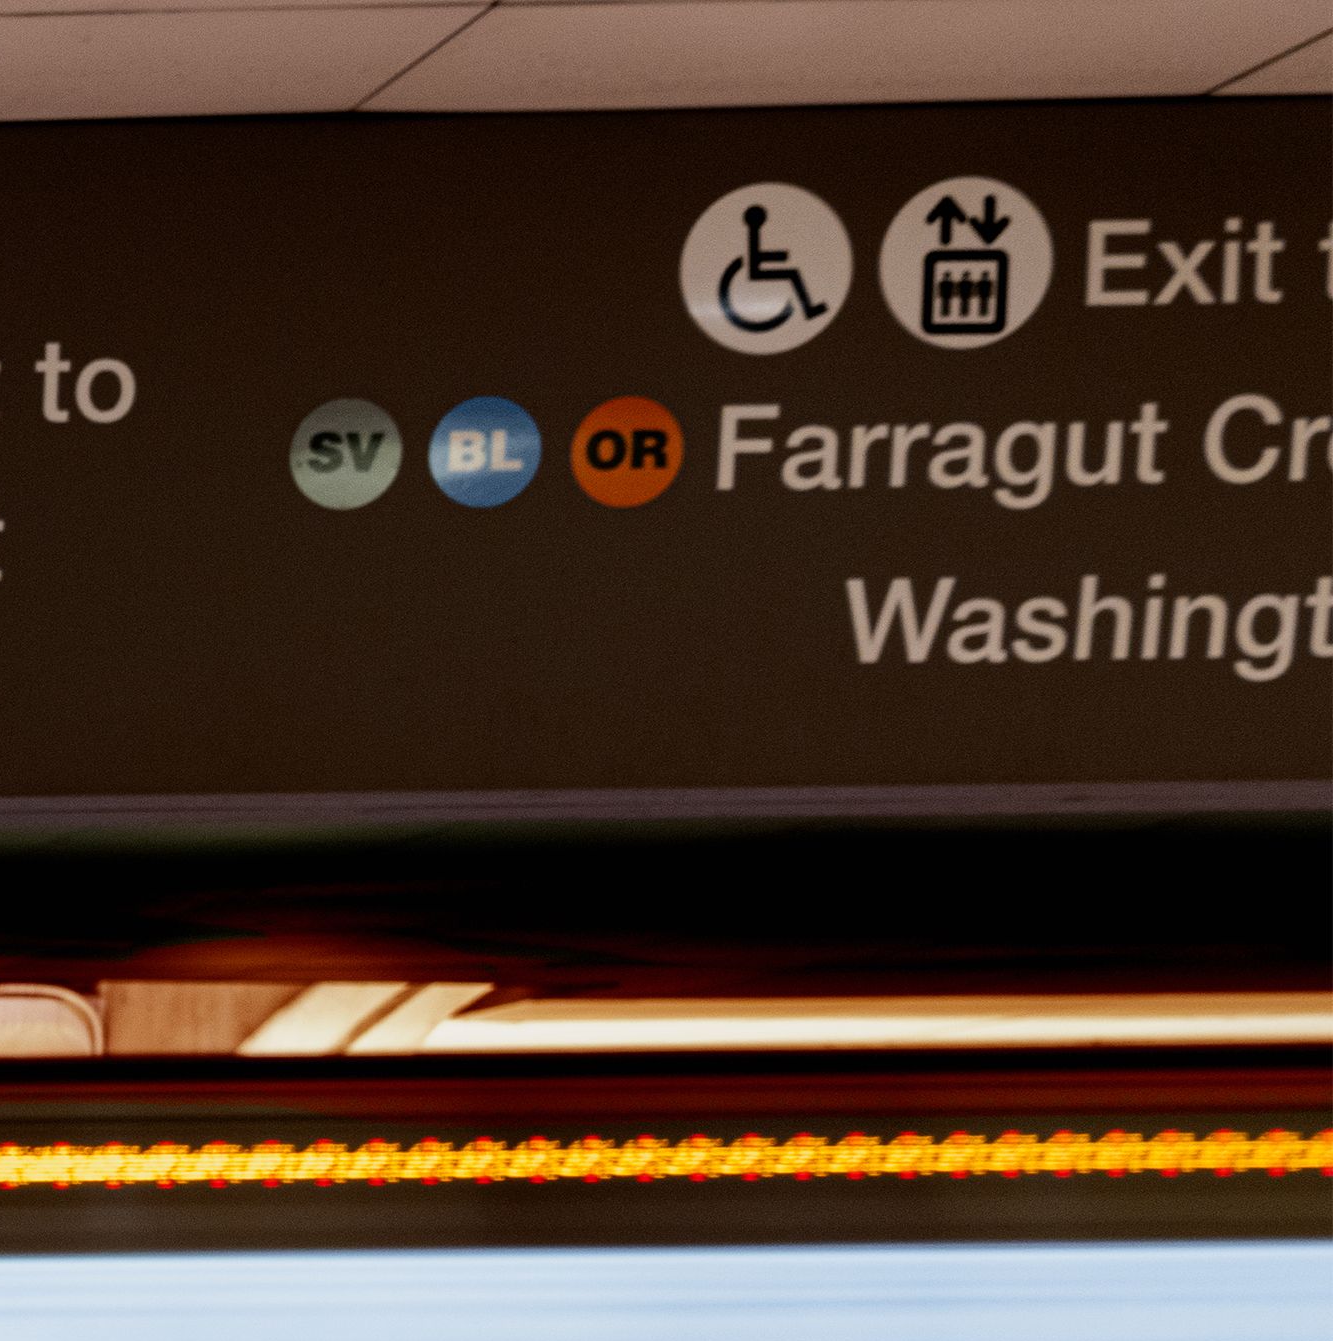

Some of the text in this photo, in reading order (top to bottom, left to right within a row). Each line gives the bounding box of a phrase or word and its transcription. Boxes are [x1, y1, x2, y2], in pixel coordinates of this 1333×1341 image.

[1086, 218, 1284, 306] Exit
[35, 343, 135, 423] to
[307, 394, 1333, 510] SV BL OR Farragut Cr
